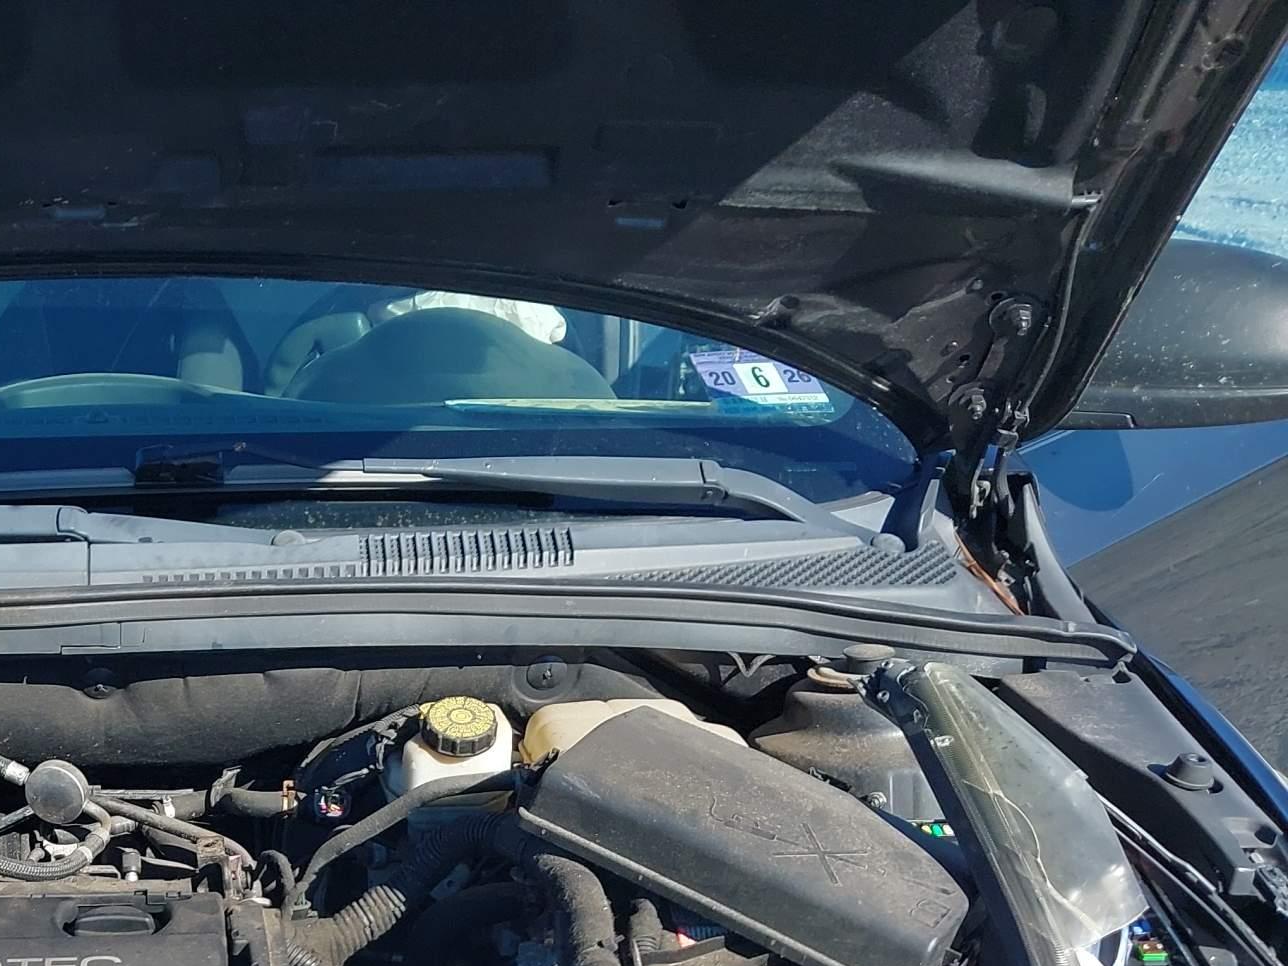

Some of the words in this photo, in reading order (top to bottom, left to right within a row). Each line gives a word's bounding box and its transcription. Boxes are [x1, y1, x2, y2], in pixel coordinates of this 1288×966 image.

[708, 370, 736, 386] 20
[751, 366, 770, 388] 6
[783, 369, 812, 384] 26
